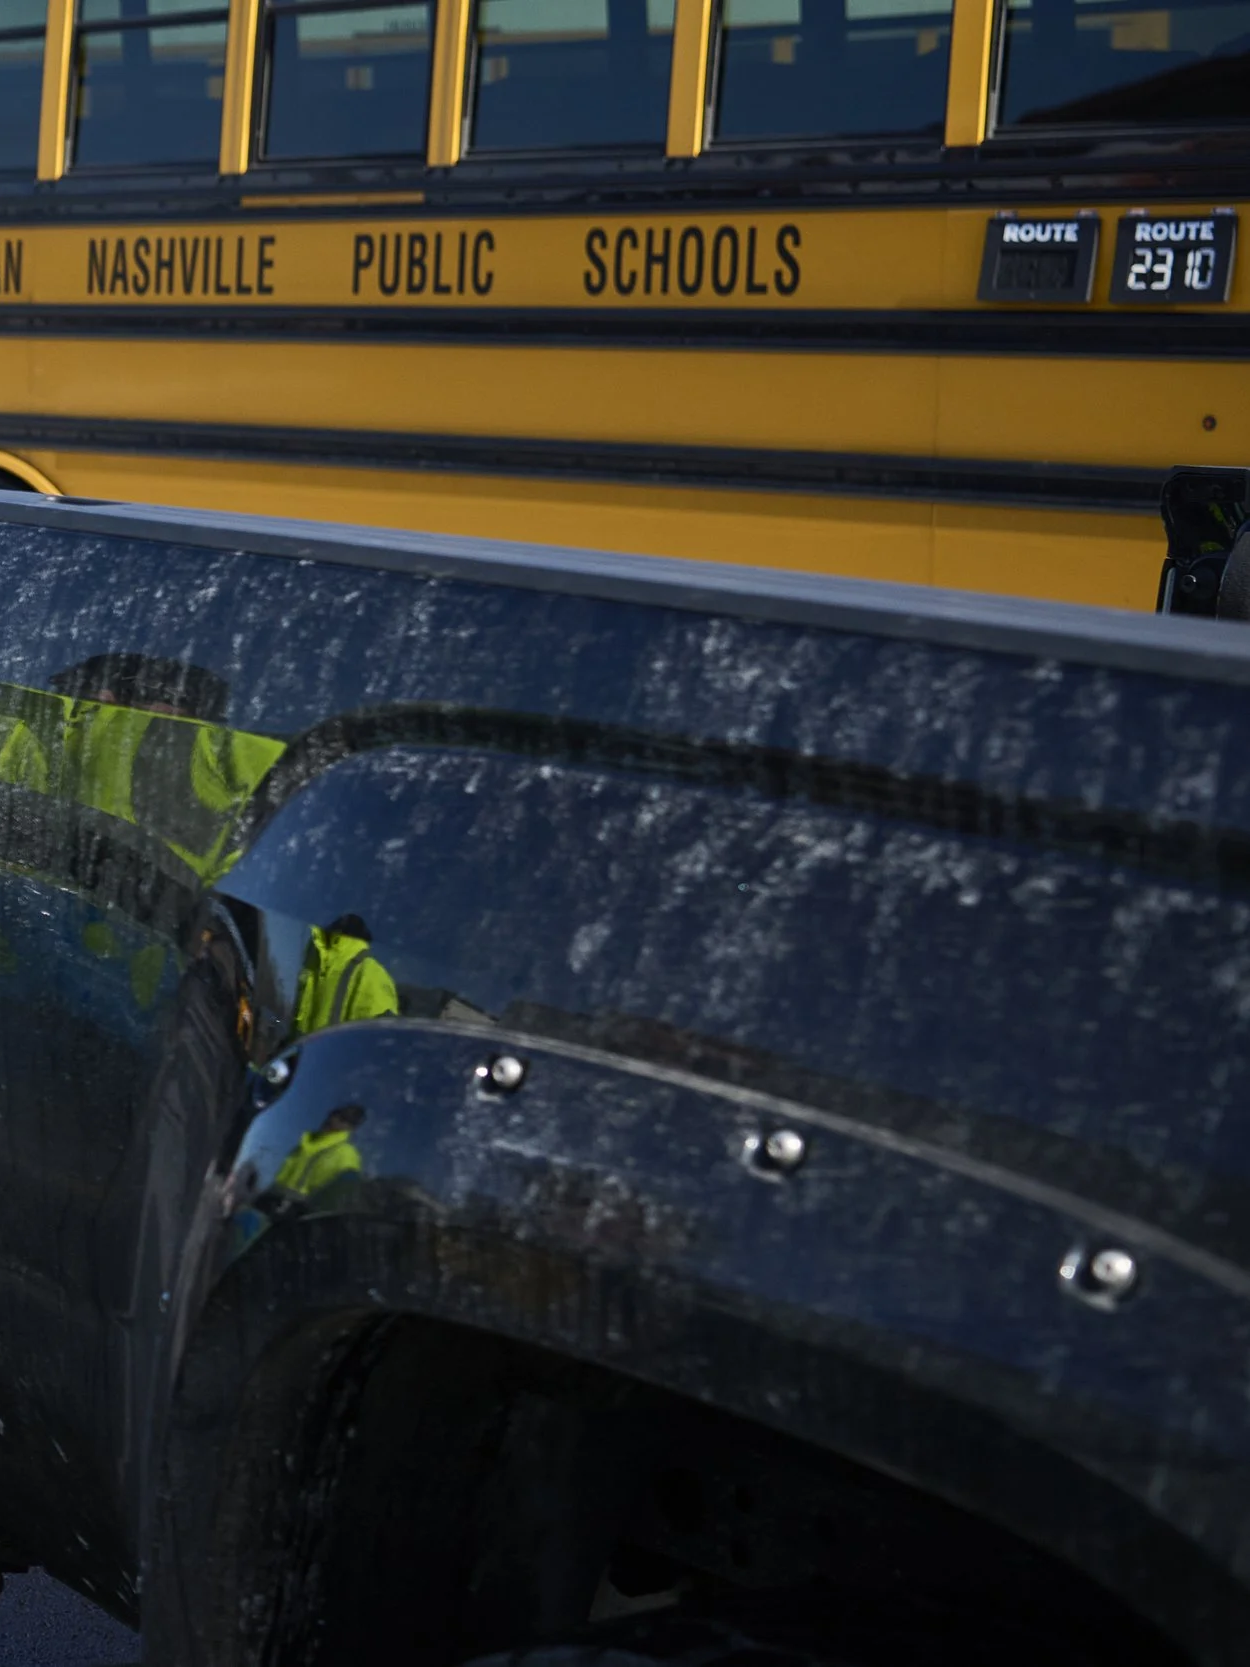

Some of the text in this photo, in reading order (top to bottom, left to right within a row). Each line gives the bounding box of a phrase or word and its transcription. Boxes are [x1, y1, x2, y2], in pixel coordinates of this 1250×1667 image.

[1002, 223, 1079, 243] ROUTE
[1134, 221, 1215, 242] ROUTE
[87, 235, 276, 296] NASHVILLE
[352, 229, 495, 296] PUBLIC
[583, 224, 801, 296] SCHOOLS
[1127, 247, 1215, 291] 2310
